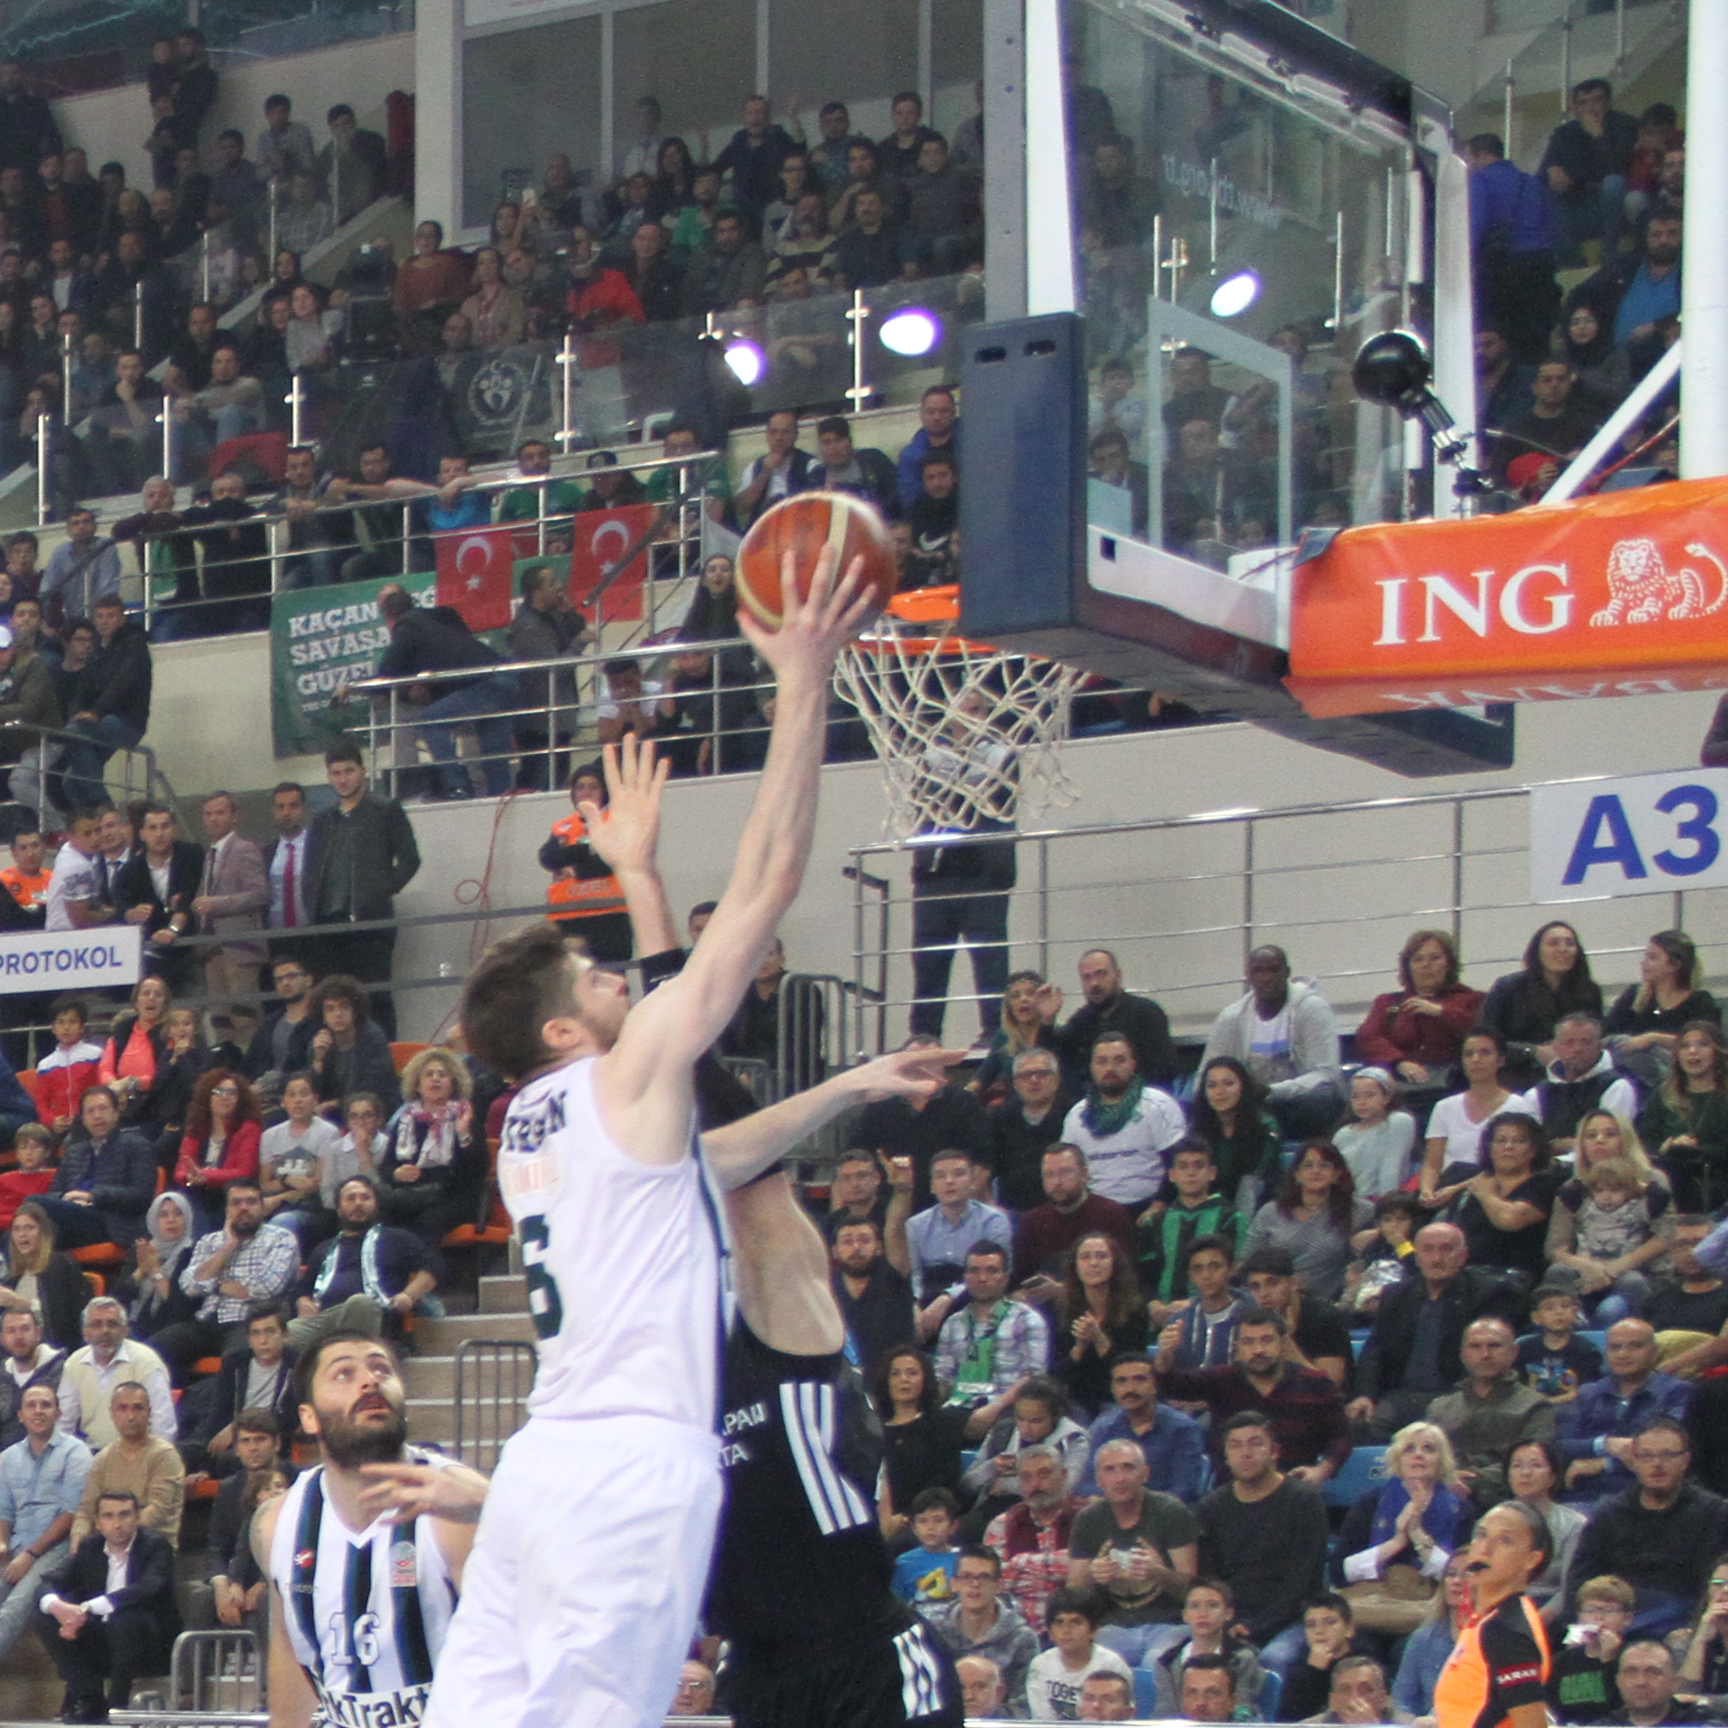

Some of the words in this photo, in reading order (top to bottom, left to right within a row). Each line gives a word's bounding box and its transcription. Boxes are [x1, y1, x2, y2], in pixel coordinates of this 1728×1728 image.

[288, 601, 380, 639] KAÇAN
[1372, 561, 1577, 647] ING
[289, 625, 394, 667] SAVAŞA
[1562, 783, 1721, 887] A3
[329, 1611, 381, 1667] 16
